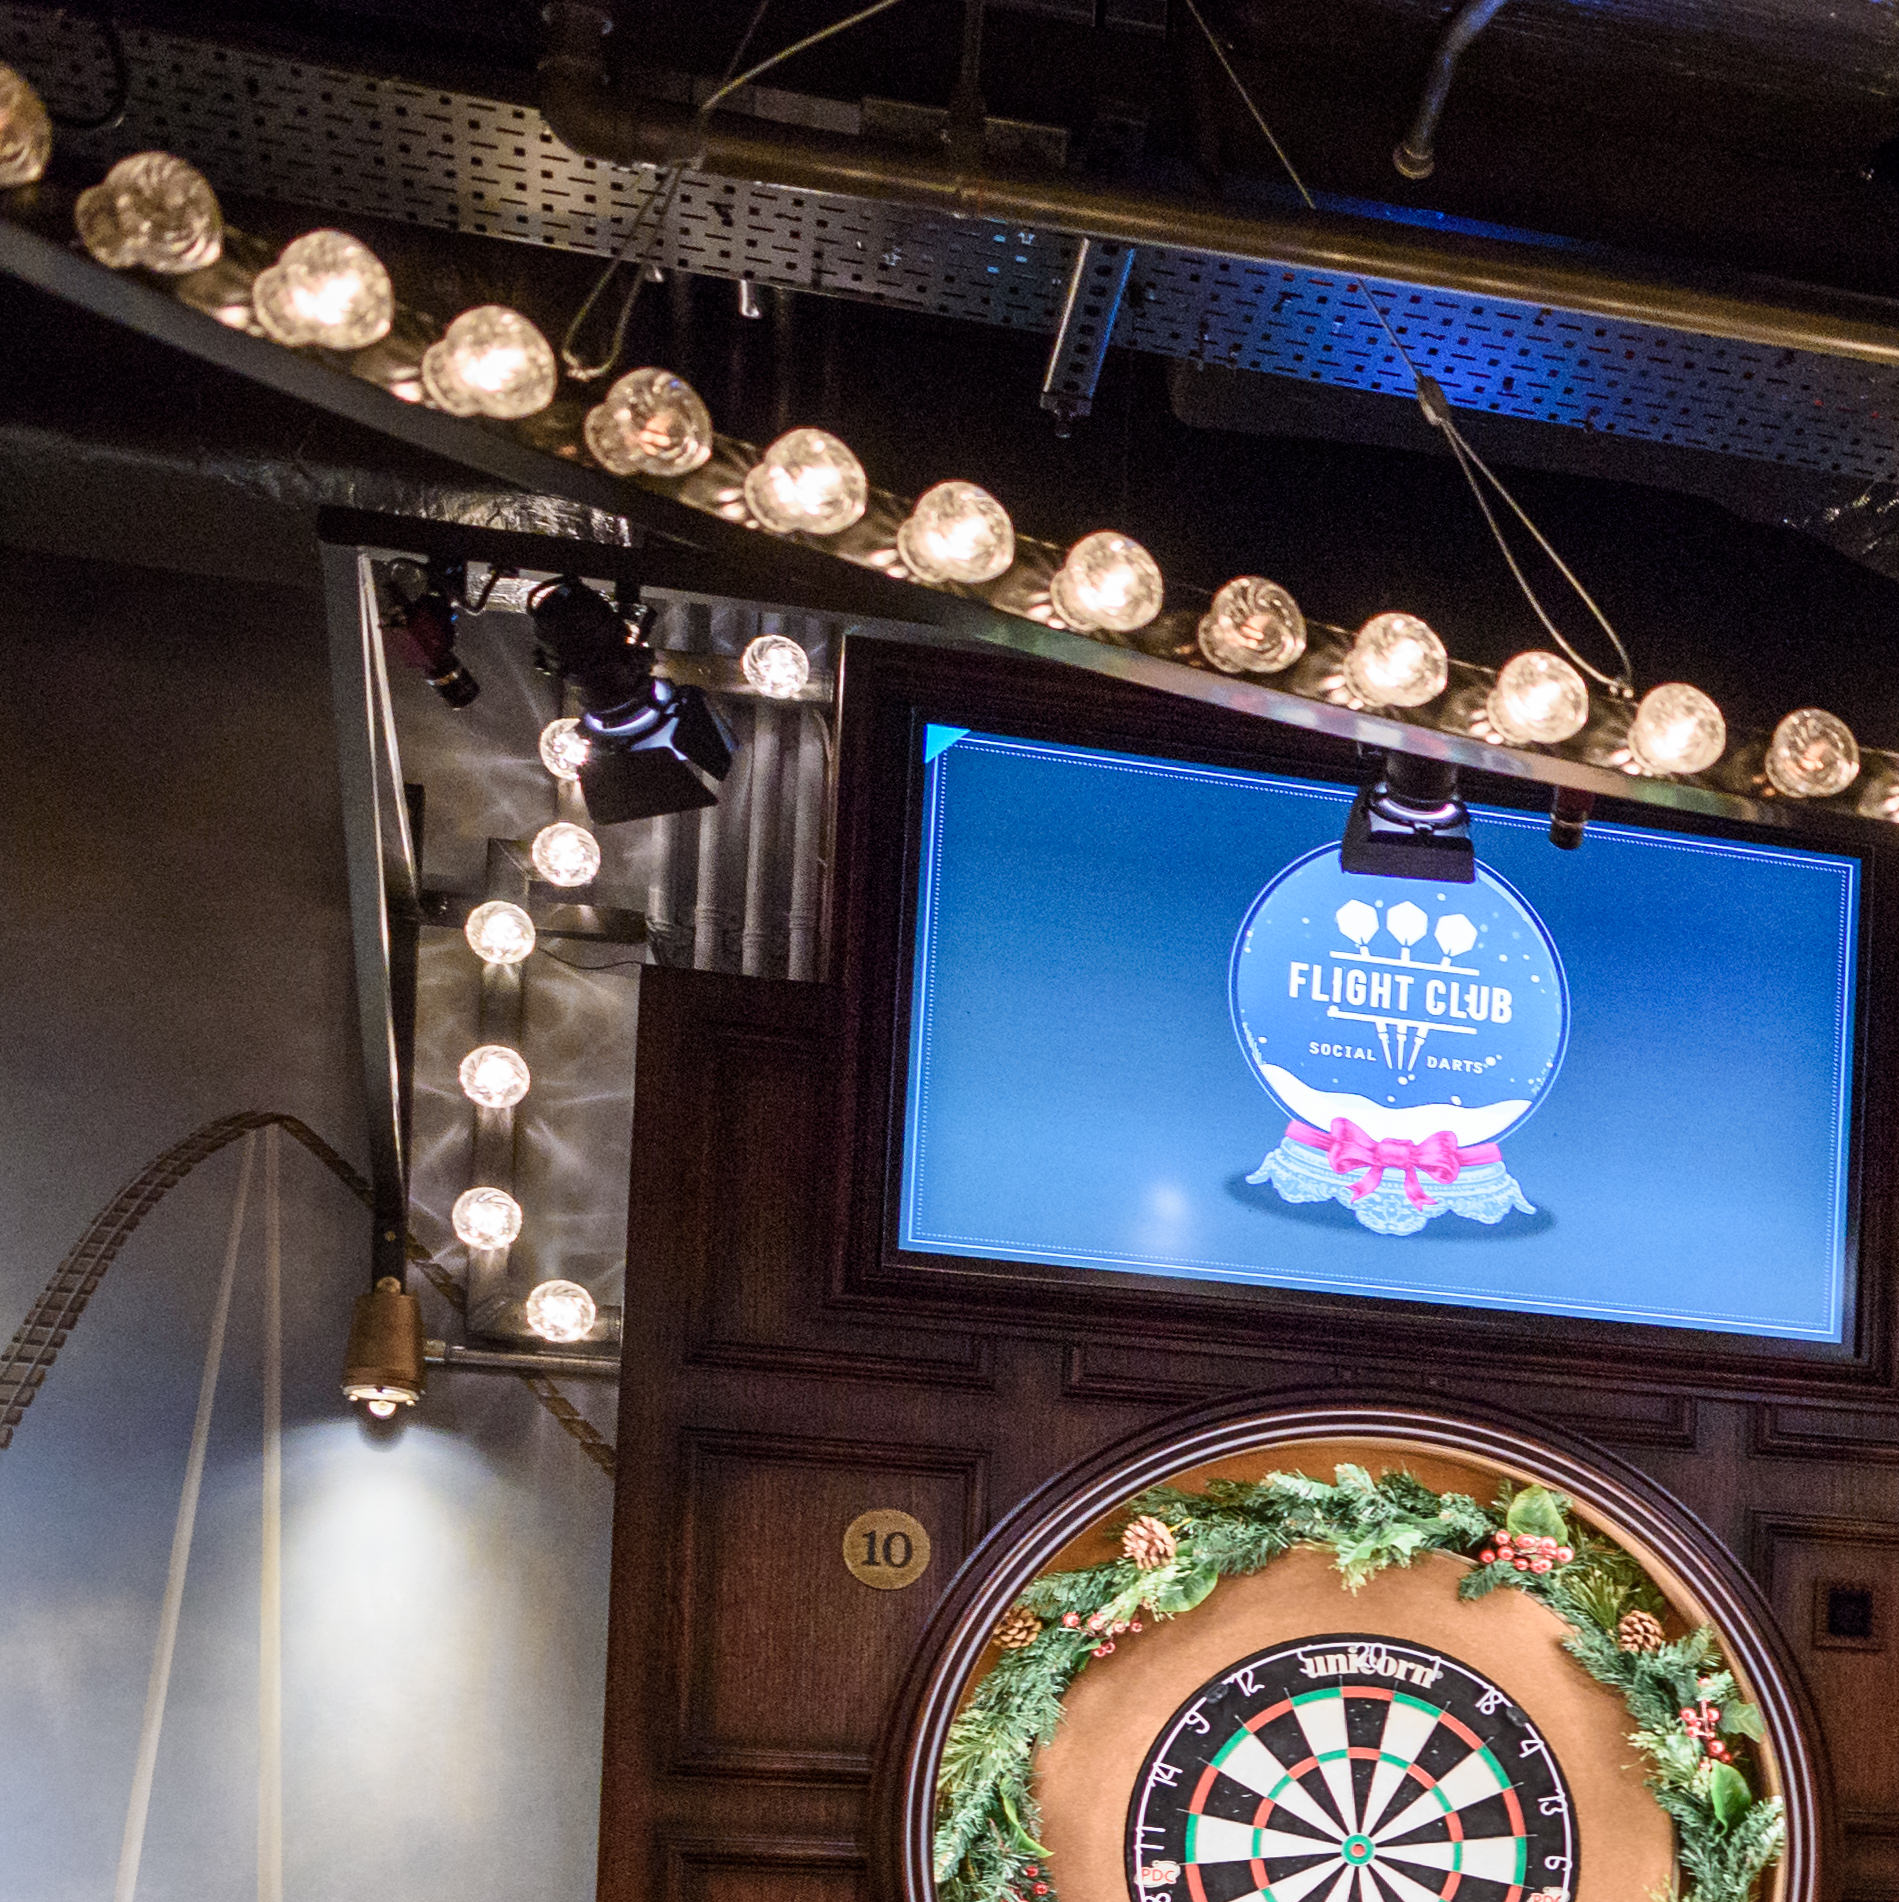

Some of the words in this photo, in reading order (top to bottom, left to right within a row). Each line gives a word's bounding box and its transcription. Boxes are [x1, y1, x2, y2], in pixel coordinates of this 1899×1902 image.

[1289, 961, 1415, 1012] FLIGHT
[1426, 979, 1513, 1024] CLUB
[1309, 1041, 1376, 1061] SOCIAL
[1426, 1055, 1484, 1075] DARTS
[861, 1530, 913, 1568] 10
[1303, 1645, 1432, 1689] unicorn
[1356, 1644, 1387, 1668] 20
[1233, 1670, 1265, 1696] 12
[1475, 1686, 1505, 1715] 18
[1185, 1711, 1211, 1734] 9
[1519, 1739, 1545, 1758] 4
[1149, 1761, 1183, 1787] 14
[1537, 1789, 1568, 1815] 13
[1136, 1826, 1165, 1854] 11
[1141, 1867, 1175, 1883] PDC
